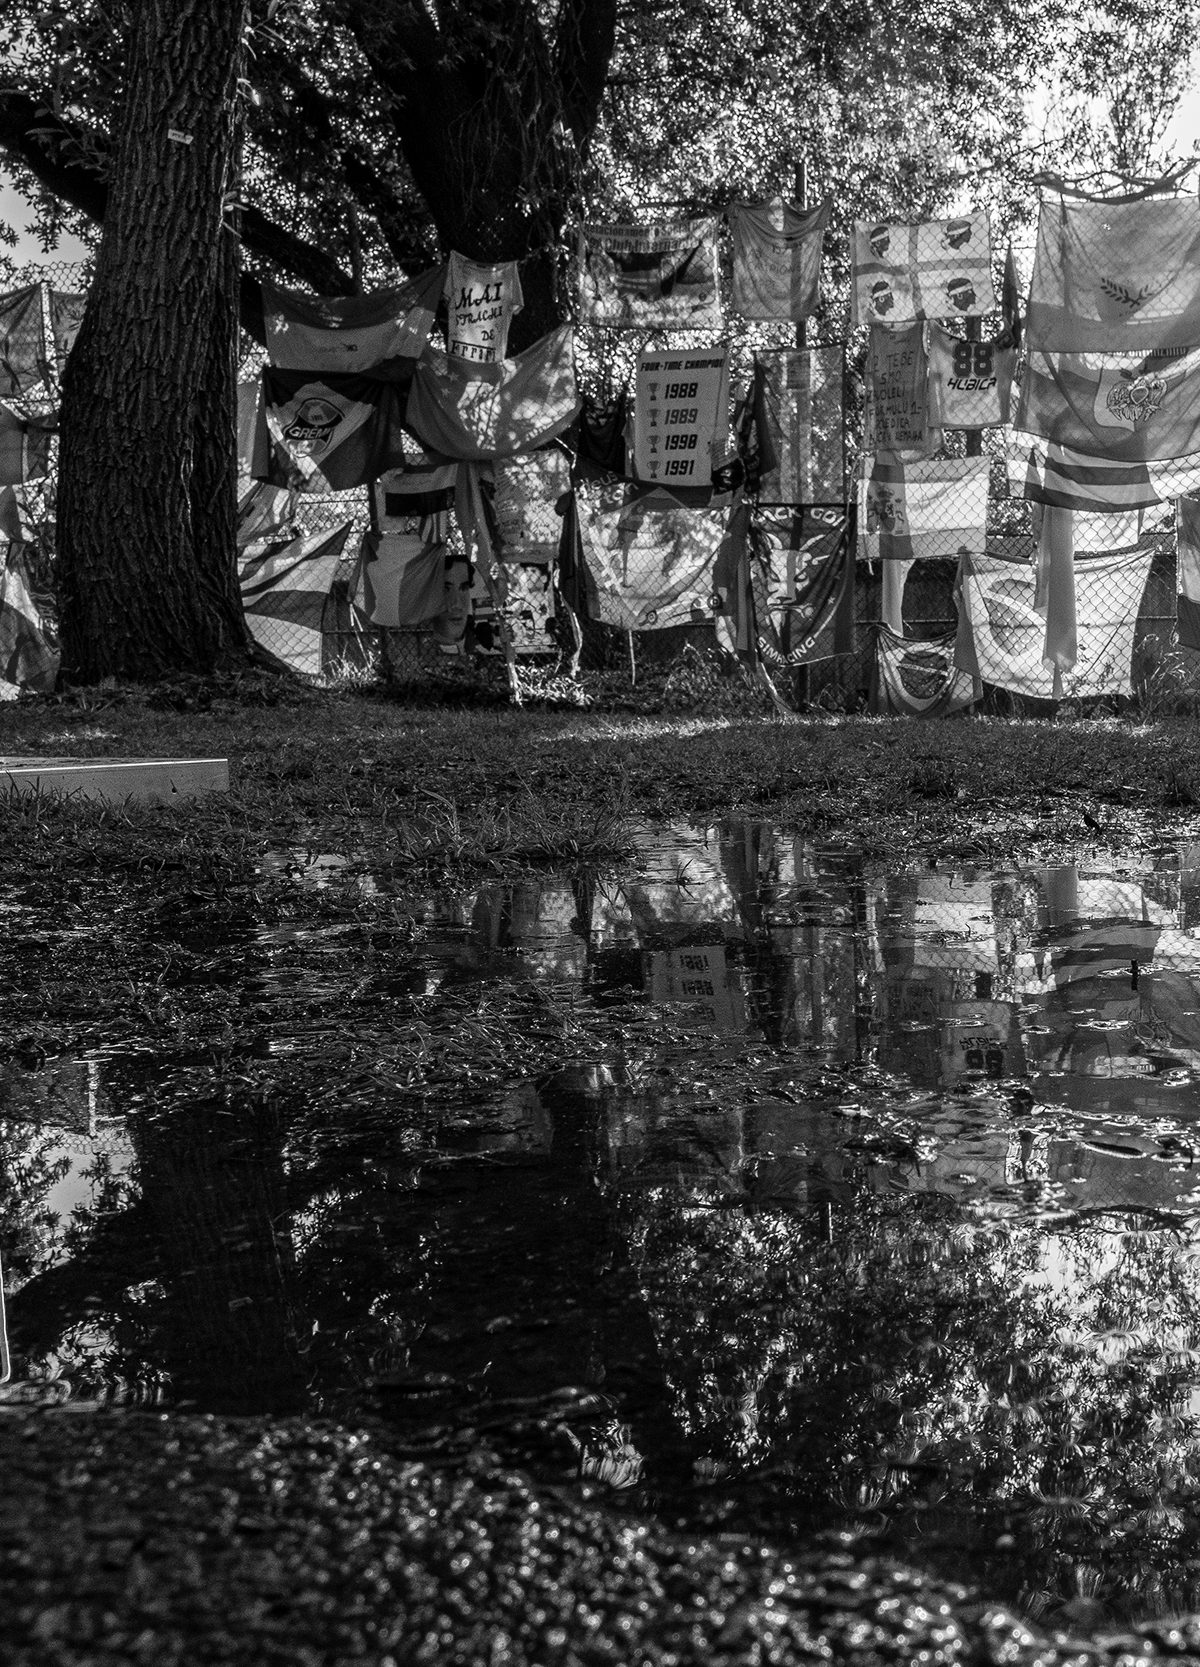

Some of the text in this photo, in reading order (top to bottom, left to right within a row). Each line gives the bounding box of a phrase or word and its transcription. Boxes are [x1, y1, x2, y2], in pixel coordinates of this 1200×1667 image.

[455, 282, 502, 310] MAI
[954, 343, 993, 378] 88
[664, 383, 698, 399] 1988
[664, 408, 698, 424] 1989
[664, 460, 695, 475] 1991
